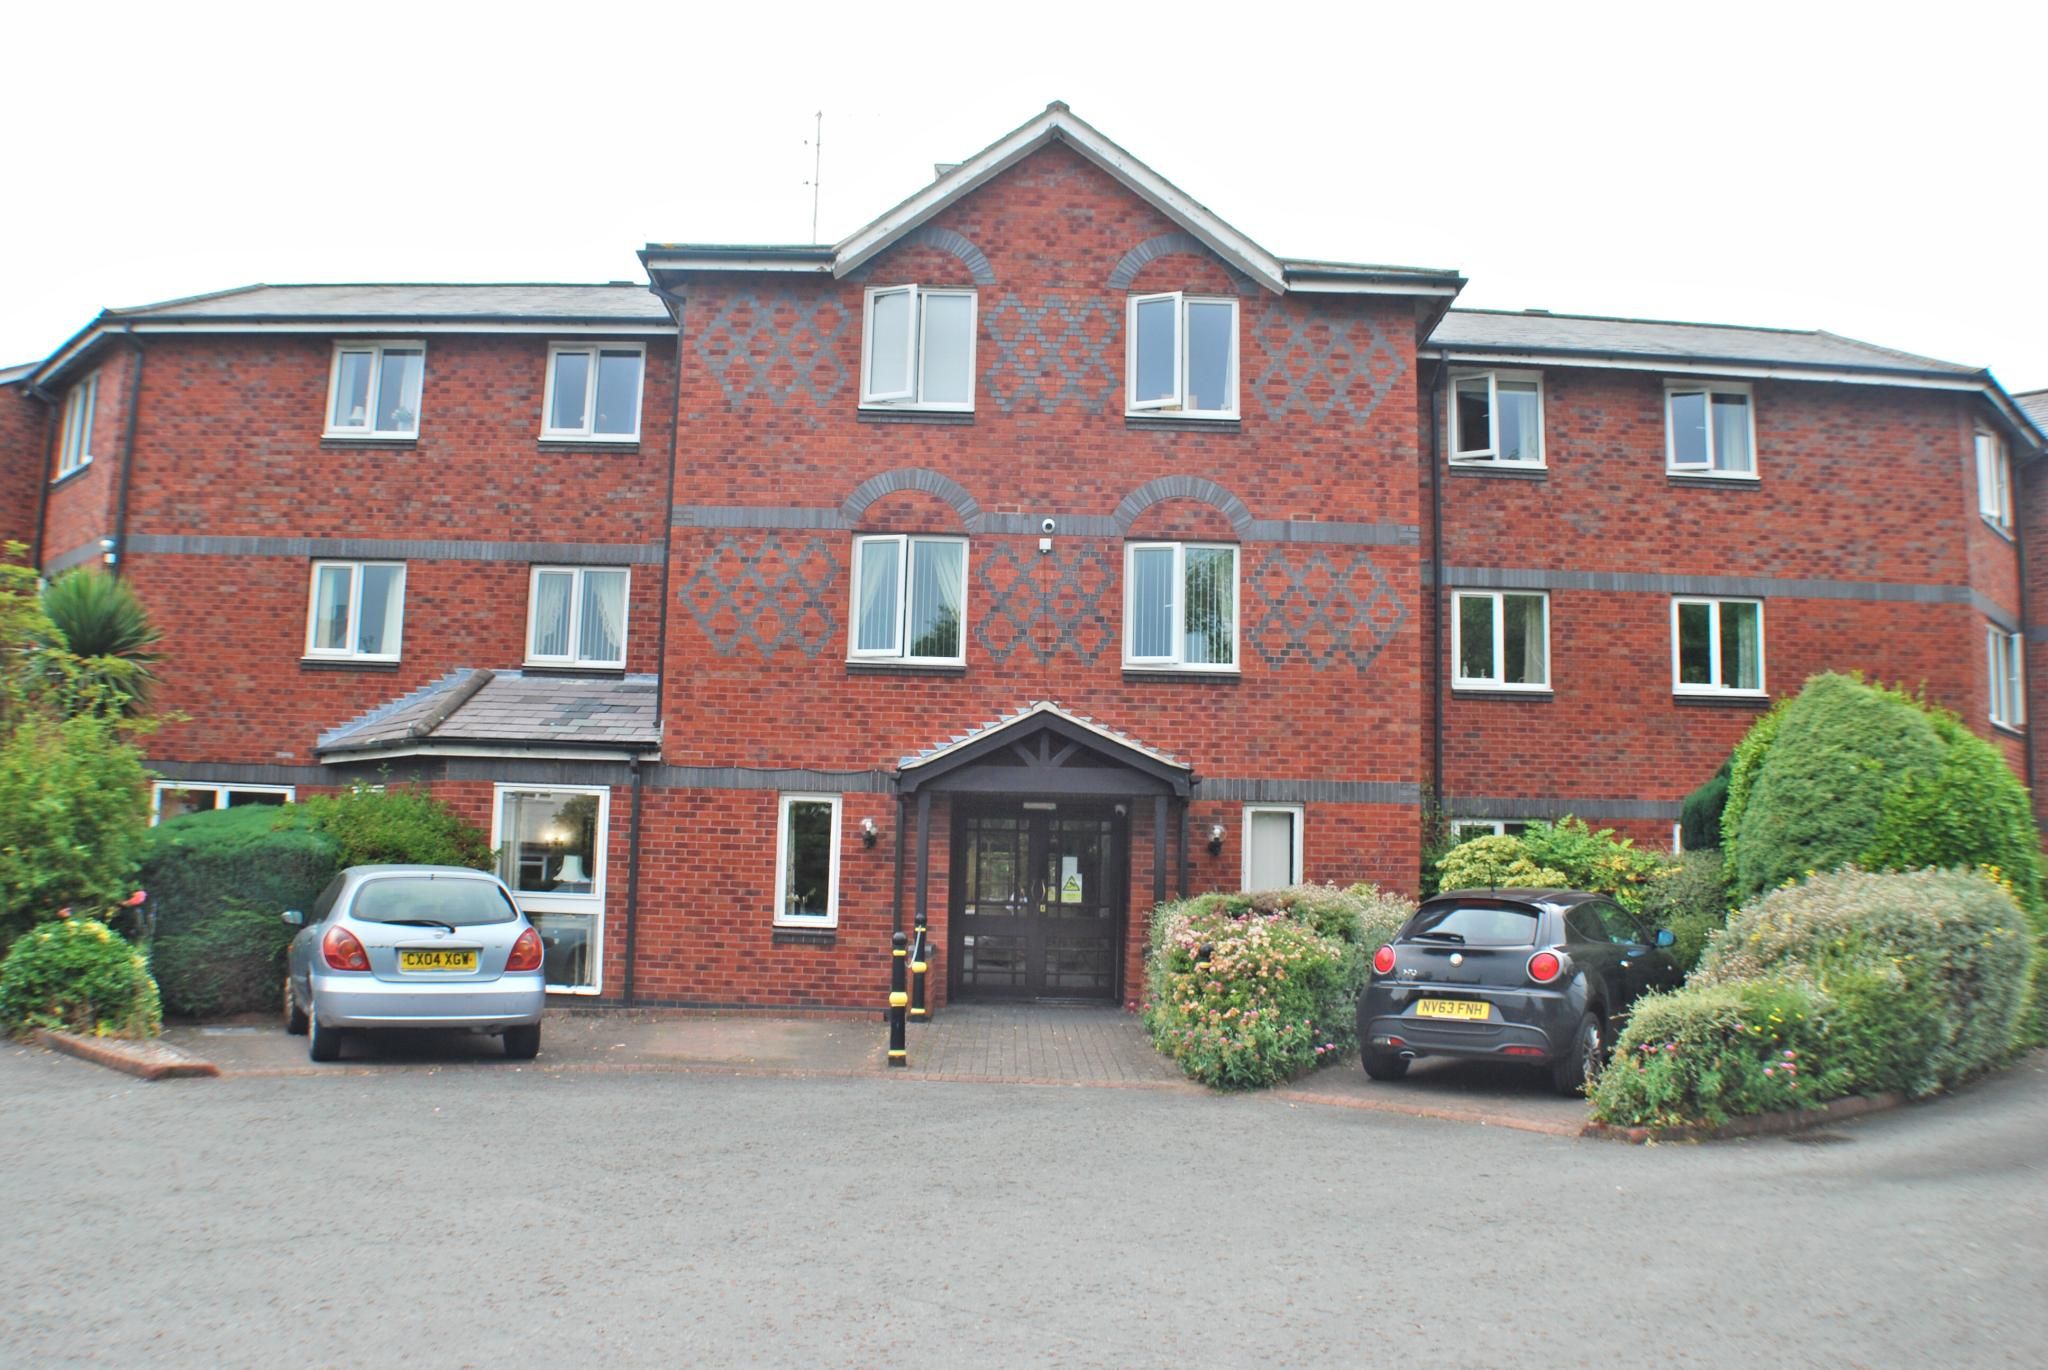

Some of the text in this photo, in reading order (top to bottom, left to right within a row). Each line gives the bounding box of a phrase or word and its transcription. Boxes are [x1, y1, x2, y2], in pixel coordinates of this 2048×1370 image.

[407, 953, 469, 965] CX04 XGW
[1423, 1000, 1483, 1015] NV63 FNH
